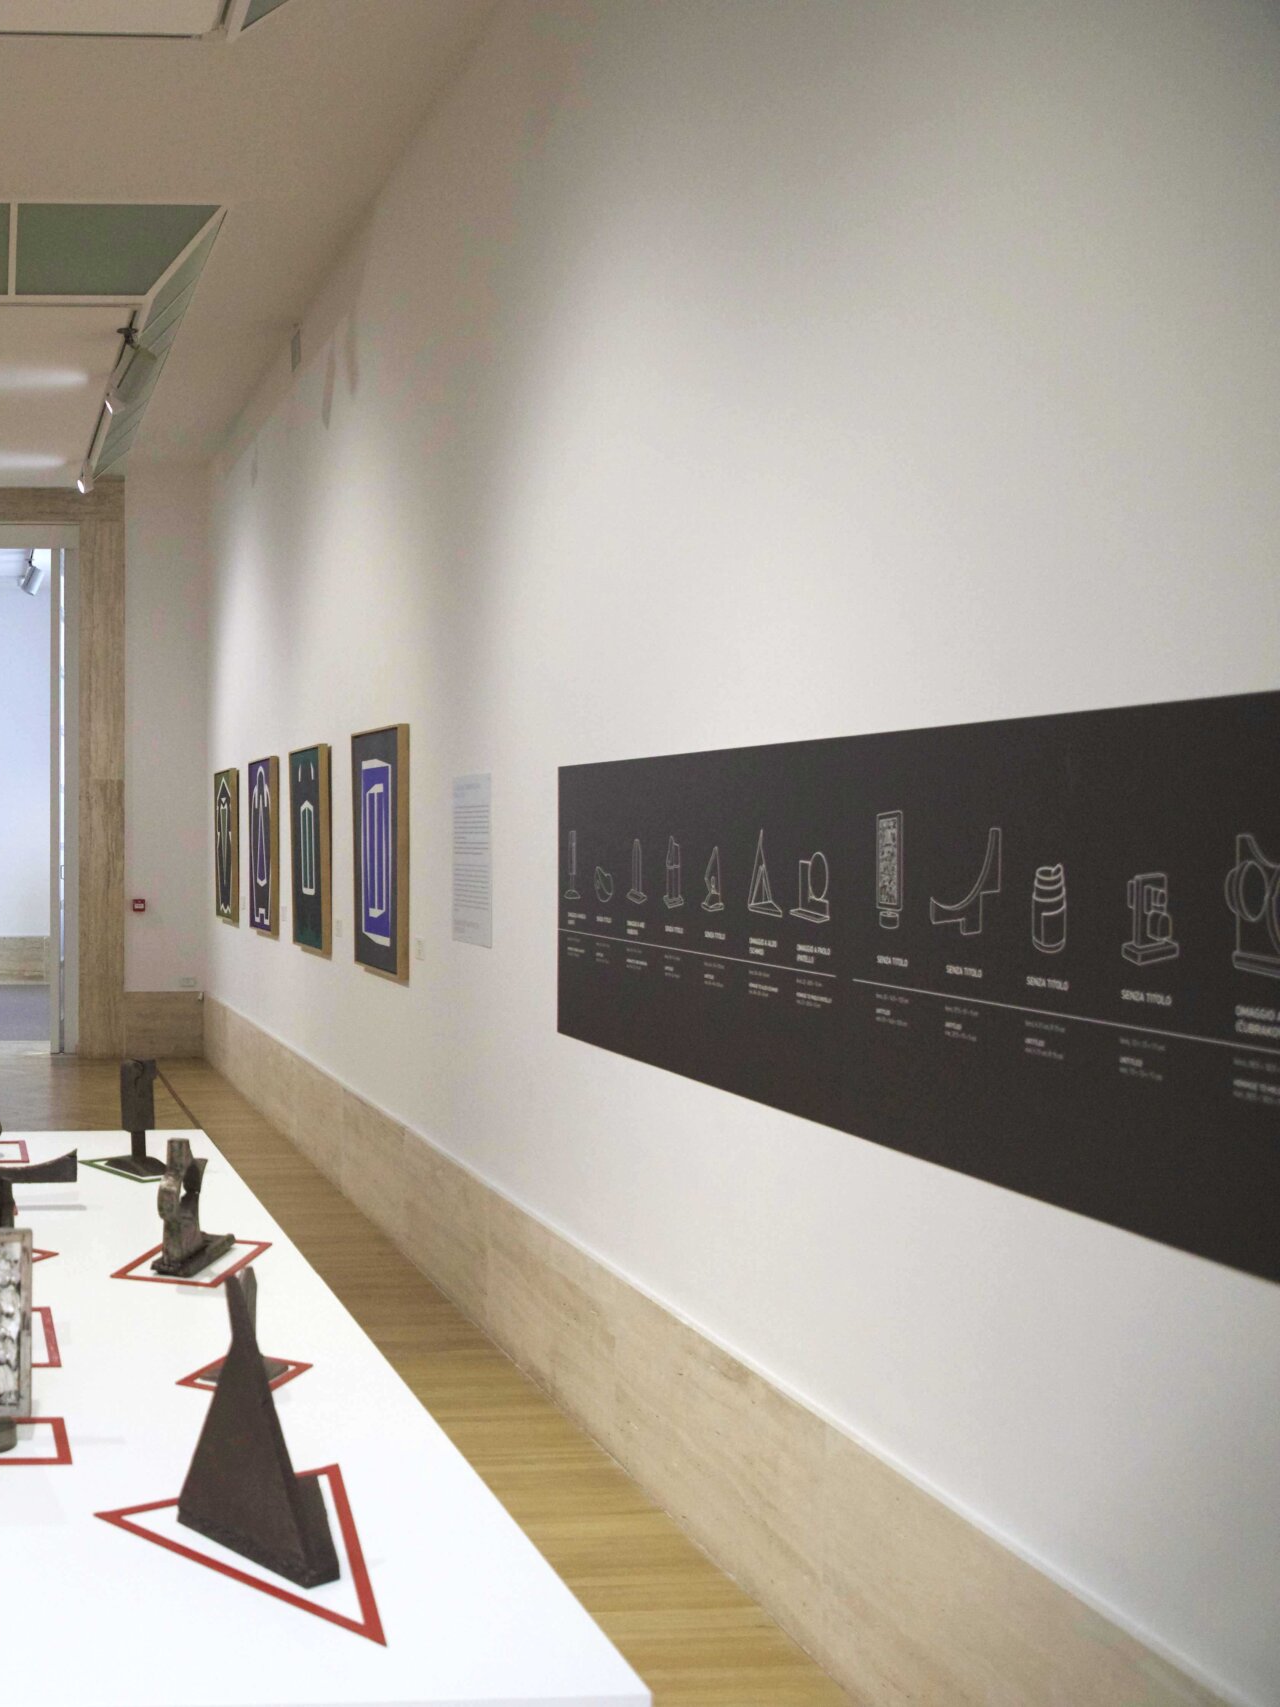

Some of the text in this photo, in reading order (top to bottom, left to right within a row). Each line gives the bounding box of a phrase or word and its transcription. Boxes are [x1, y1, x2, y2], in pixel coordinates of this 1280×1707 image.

[876, 955, 908, 967] SENZA TITOLO
[945, 964, 983, 978] SENZA TITOLO
[1026, 976, 1069, 991] SENZA TITOLO
[1120, 989, 1172, 1006] SENZA TITOLO
